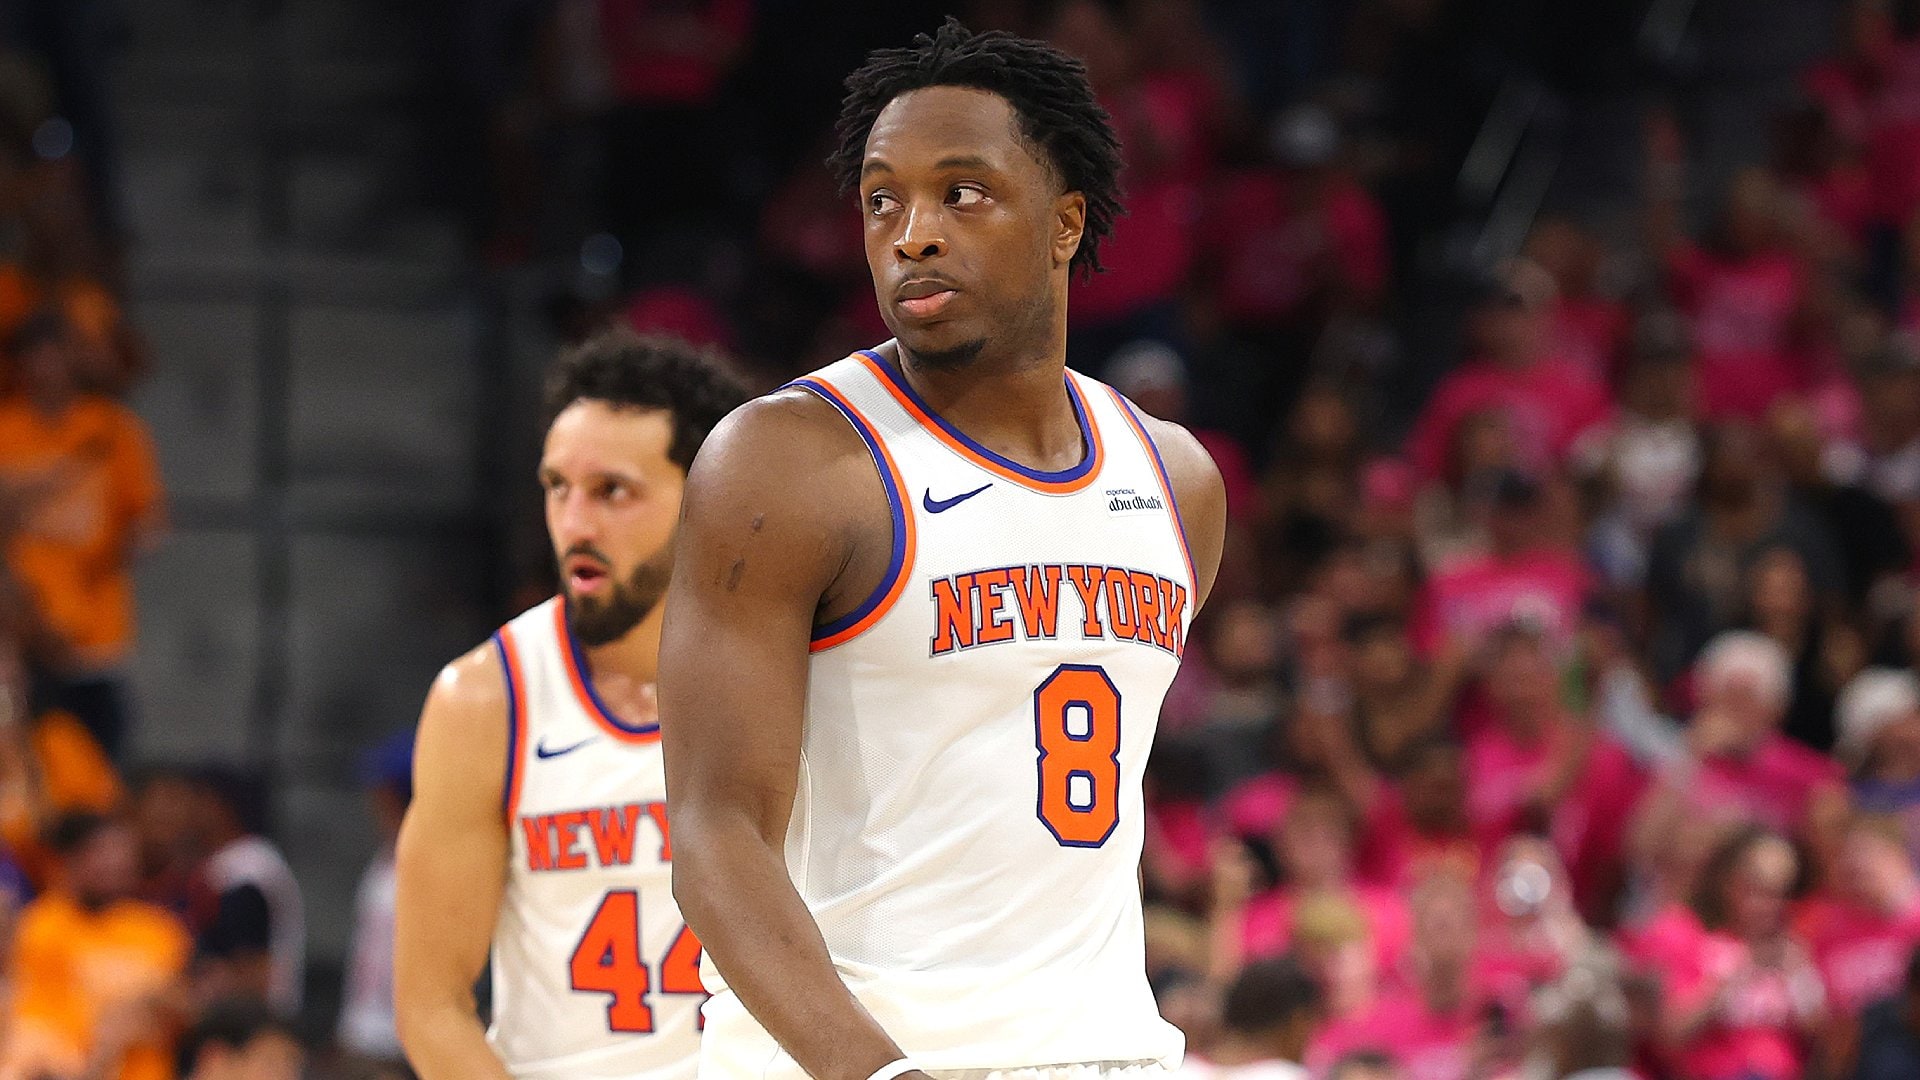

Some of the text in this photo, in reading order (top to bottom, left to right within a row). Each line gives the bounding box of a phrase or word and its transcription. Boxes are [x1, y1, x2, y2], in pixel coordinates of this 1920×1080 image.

[1108, 495, 1163, 512] abu dhabi
[929, 563, 1187, 664] NEW YORK
[1033, 663, 1122, 849] 8
[520, 803, 641, 872] NEW
